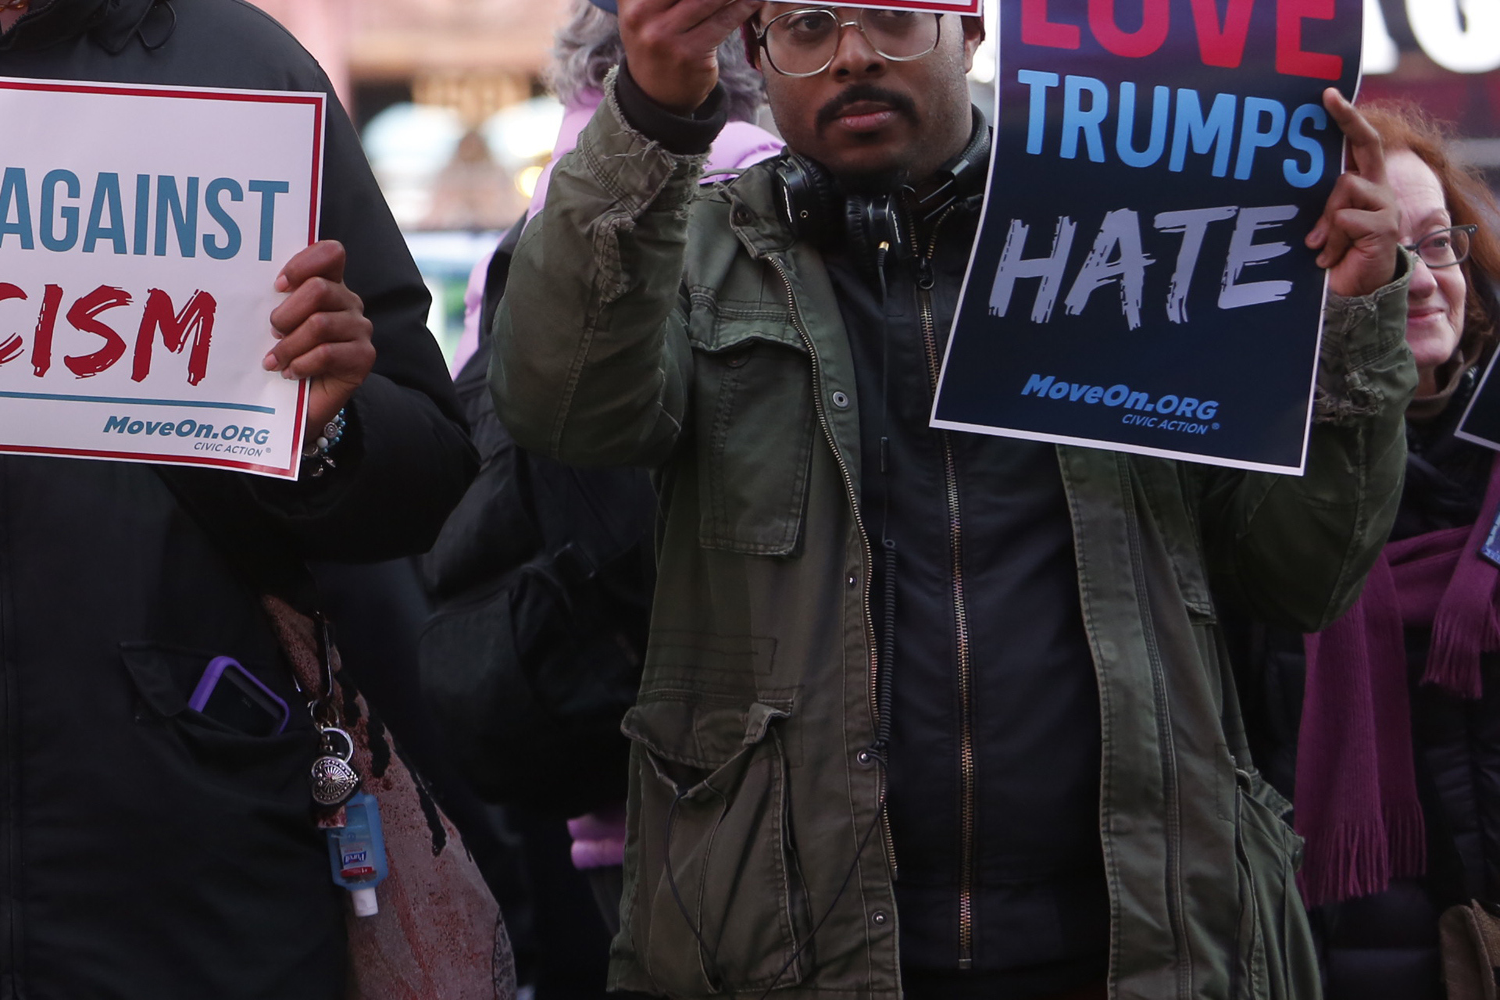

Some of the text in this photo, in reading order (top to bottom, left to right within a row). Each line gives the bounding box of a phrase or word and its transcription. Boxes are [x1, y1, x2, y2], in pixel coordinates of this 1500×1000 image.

[1017, 69, 1326, 189] TRUMPS
[988, 204, 1299, 331] HATE
[1021, 373, 1219, 420] MoveOn.ORG
[103, 415, 270, 445] MoveOn.ORG
[1121, 413, 1158, 428] CIVIC
[193, 441, 223, 452] CIVIC
